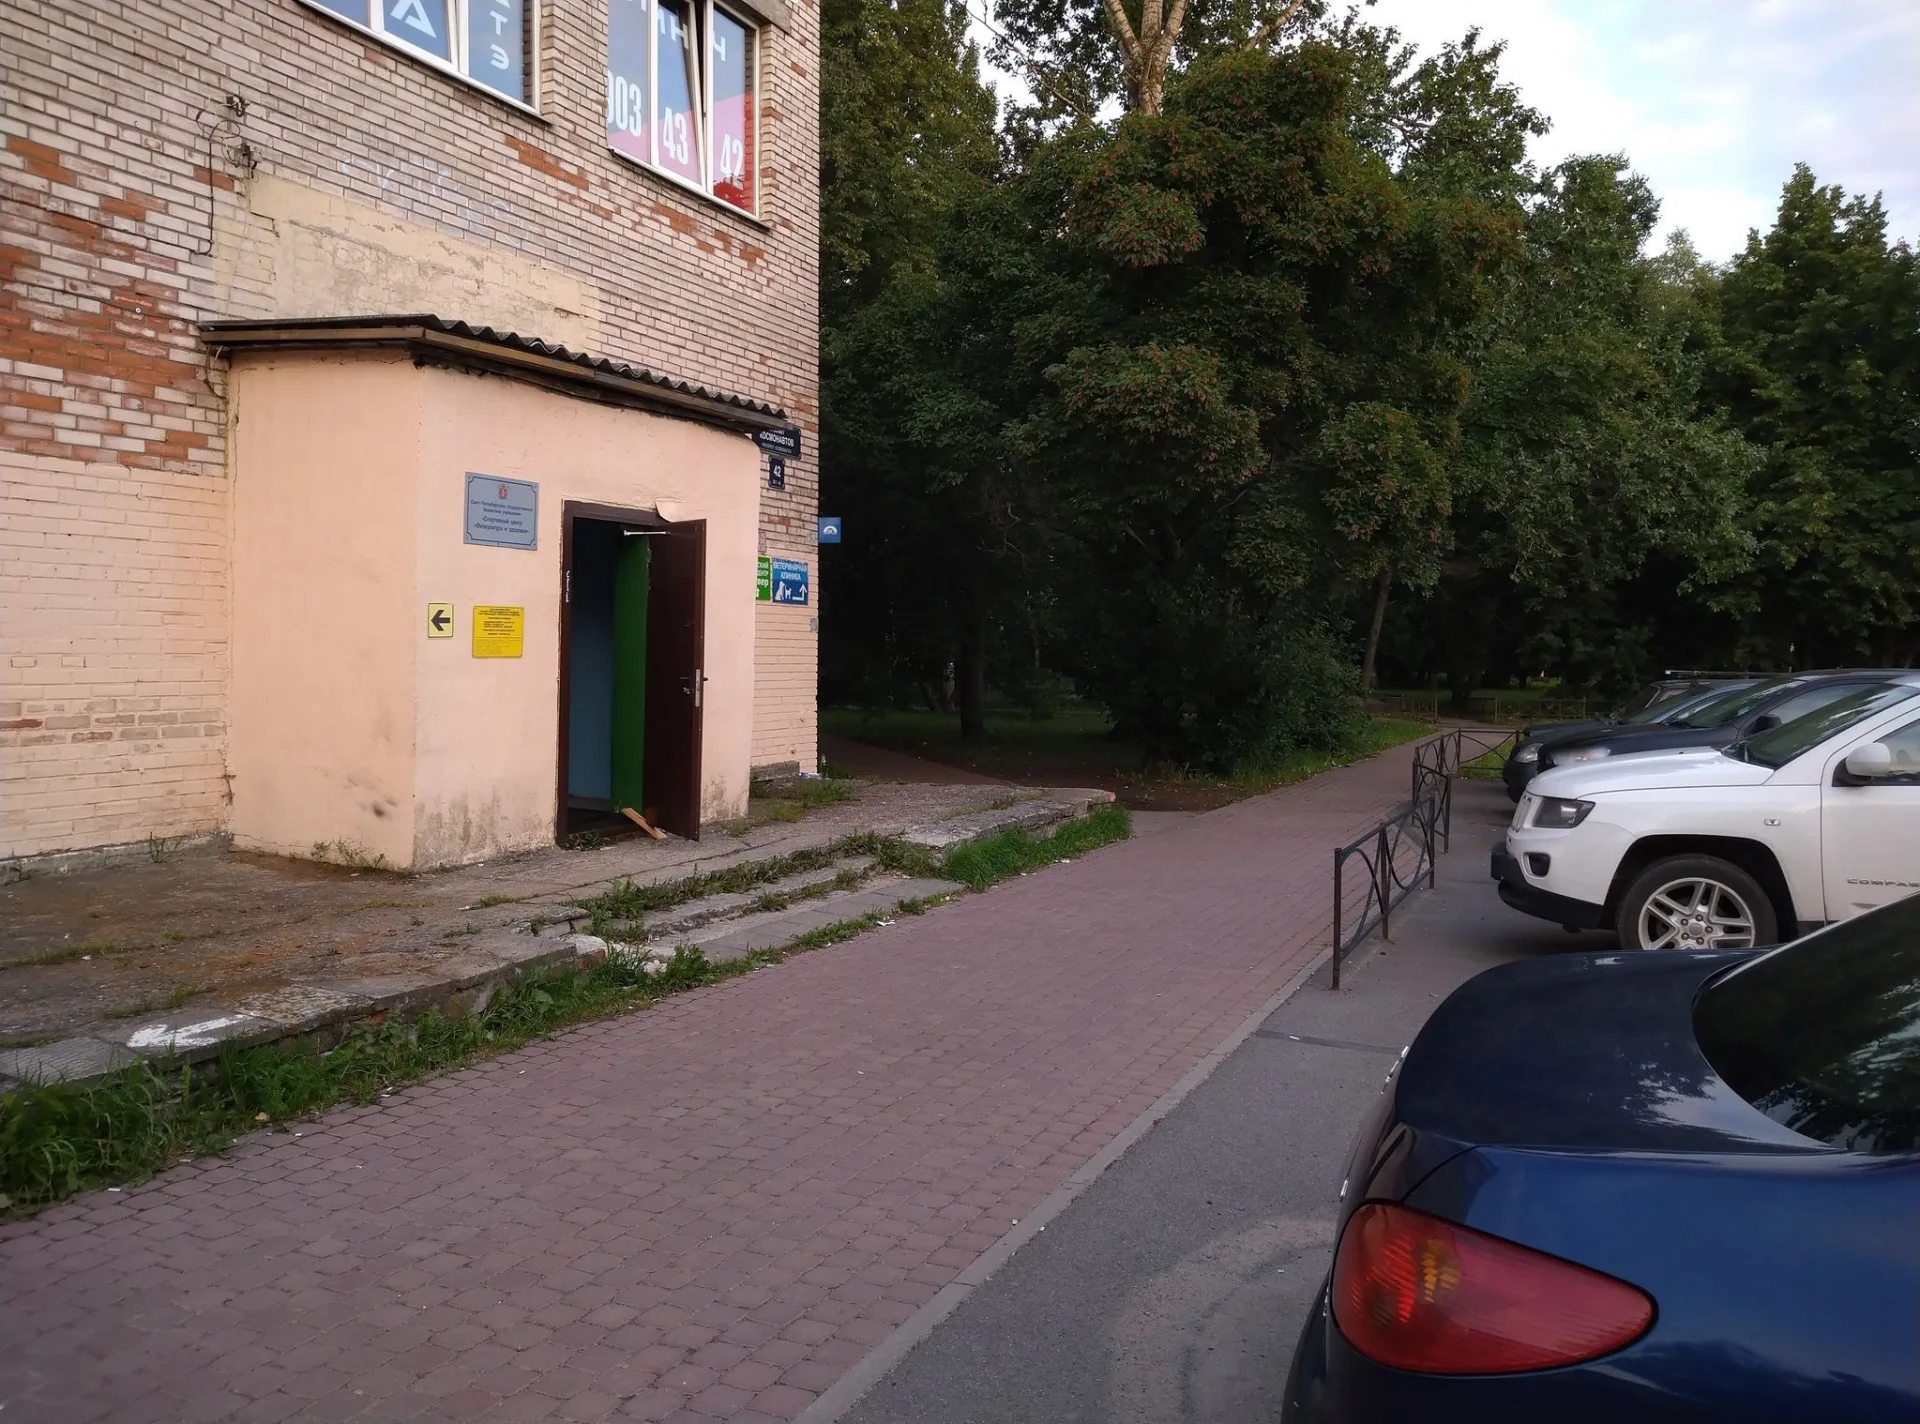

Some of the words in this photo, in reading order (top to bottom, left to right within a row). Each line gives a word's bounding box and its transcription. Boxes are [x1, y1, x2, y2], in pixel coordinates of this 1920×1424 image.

[662, 106, 689, 165] 43
[720, 133, 744, 190] 42
[773, 464, 782, 478] 42
[780, 571, 801, 581] КЛИНИКА
